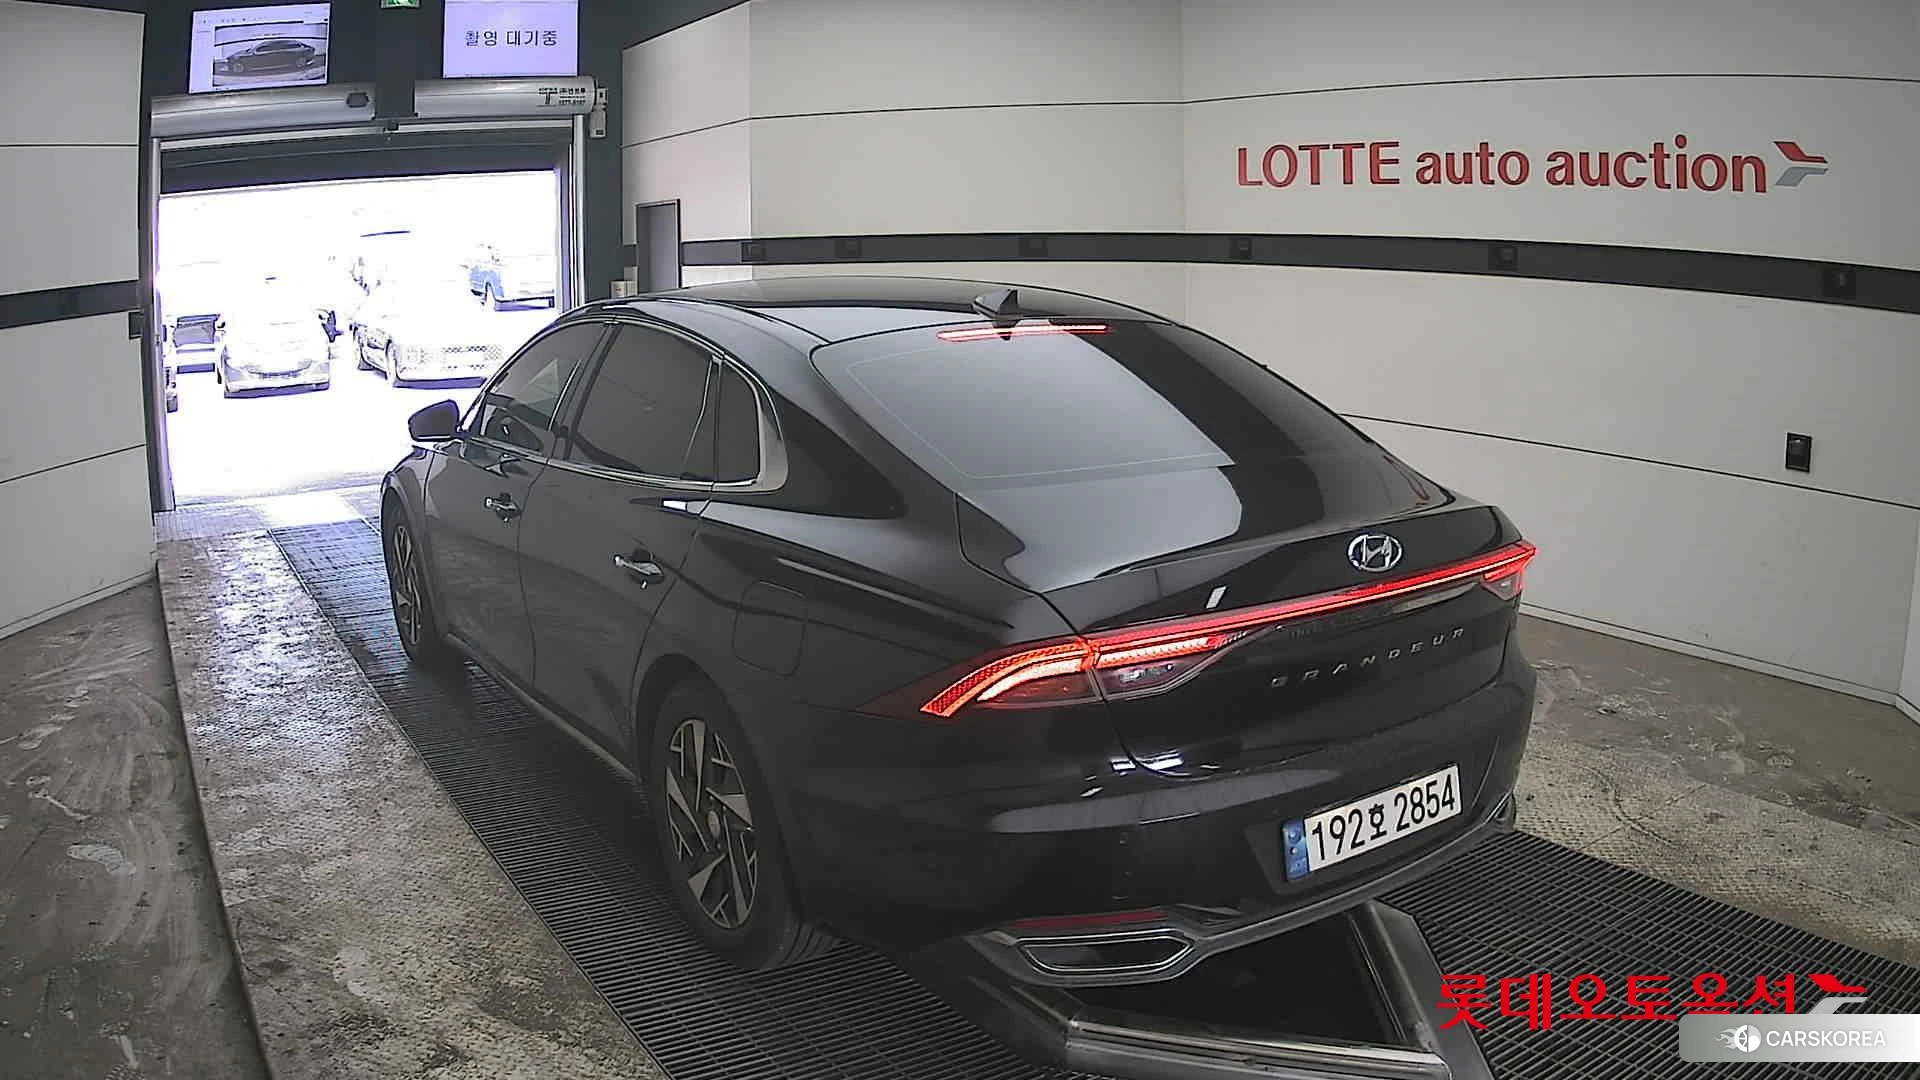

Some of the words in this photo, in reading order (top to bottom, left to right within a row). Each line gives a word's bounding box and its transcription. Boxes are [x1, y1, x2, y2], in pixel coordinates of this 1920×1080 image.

[506, 30, 558, 47] 대기중
[1237, 141, 1400, 188] LOTTE
[1415, 142, 1530, 186] auto
[1546, 134, 1767, 194] auction
[1271, 627, 1464, 688] GRANDEUR
[1311, 803, 1387, 861] 192호
[1394, 774, 1455, 833] 2854
